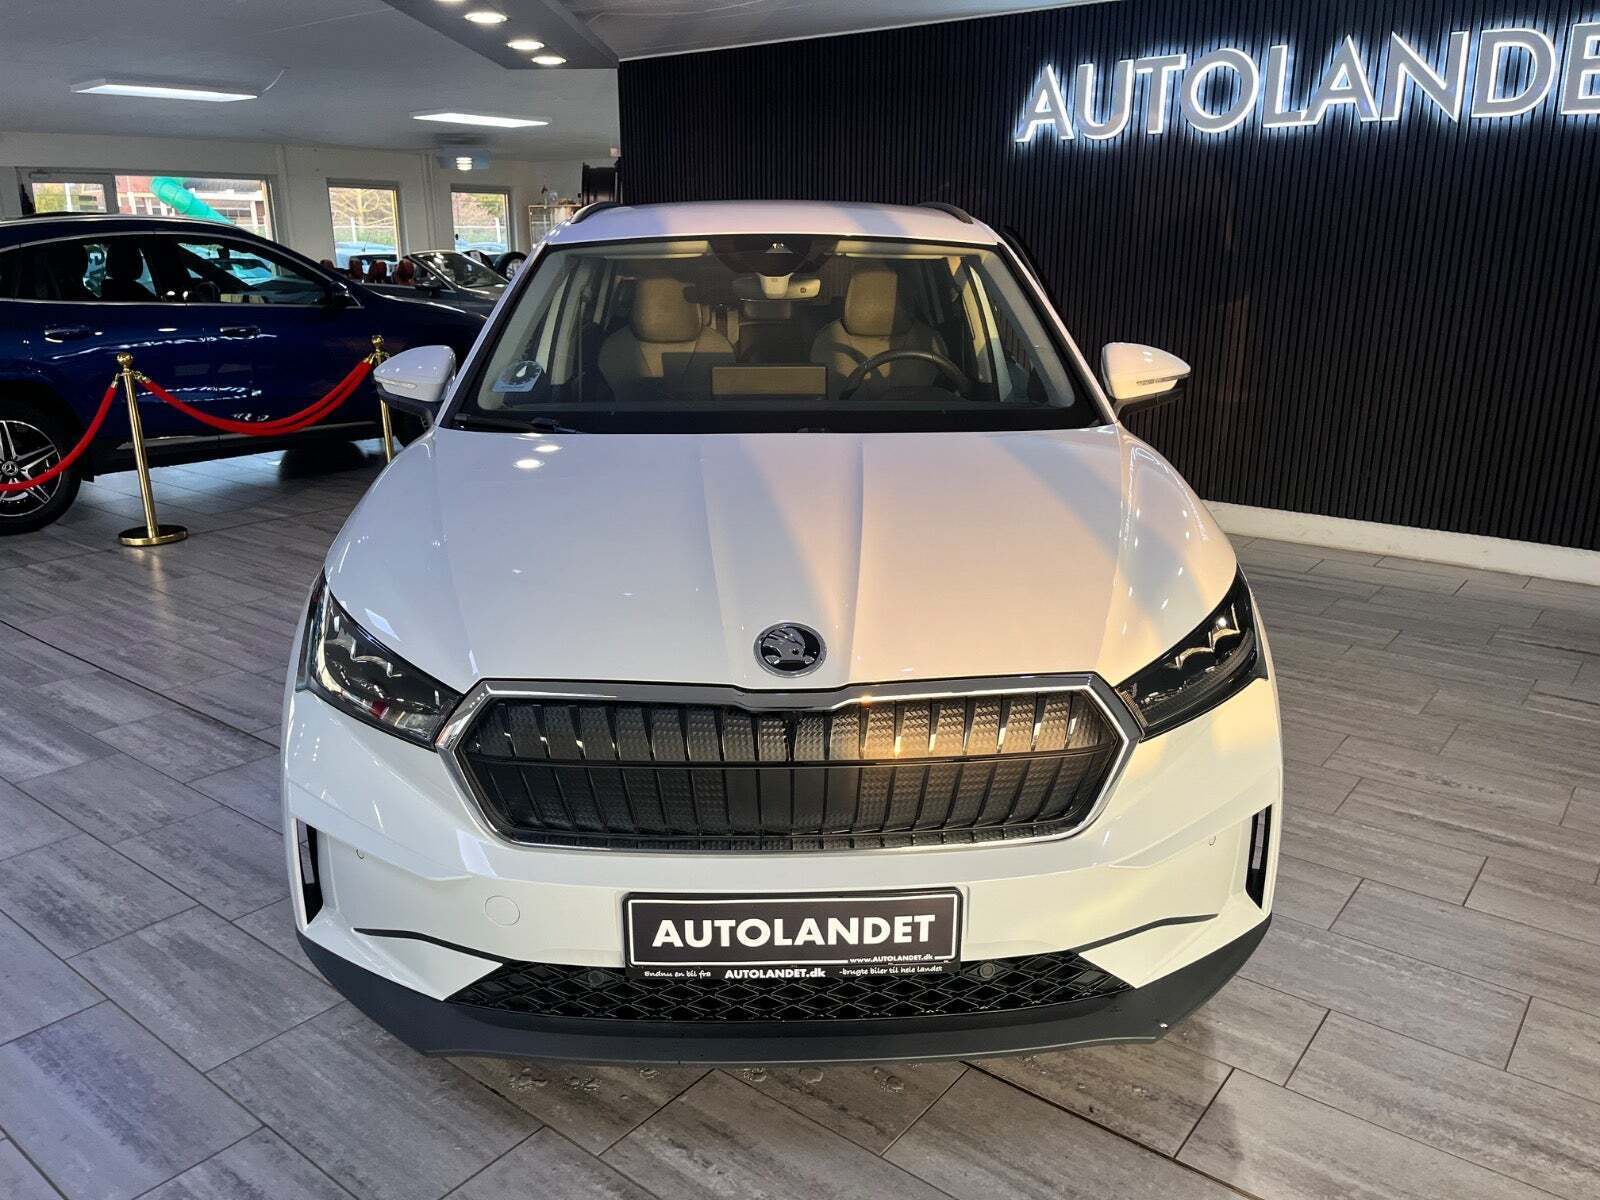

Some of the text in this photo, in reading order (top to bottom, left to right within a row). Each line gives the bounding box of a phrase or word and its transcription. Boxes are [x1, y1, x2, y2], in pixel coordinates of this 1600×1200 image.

[652, 914, 936, 948] AUTOLANDET
[849, 953, 933, 963] www.AUTOLANDET.dk
[725, 967, 826, 979] AUTOLANDET.dk
[870, 967, 887, 975] biler
[889, 966, 899, 974] til
